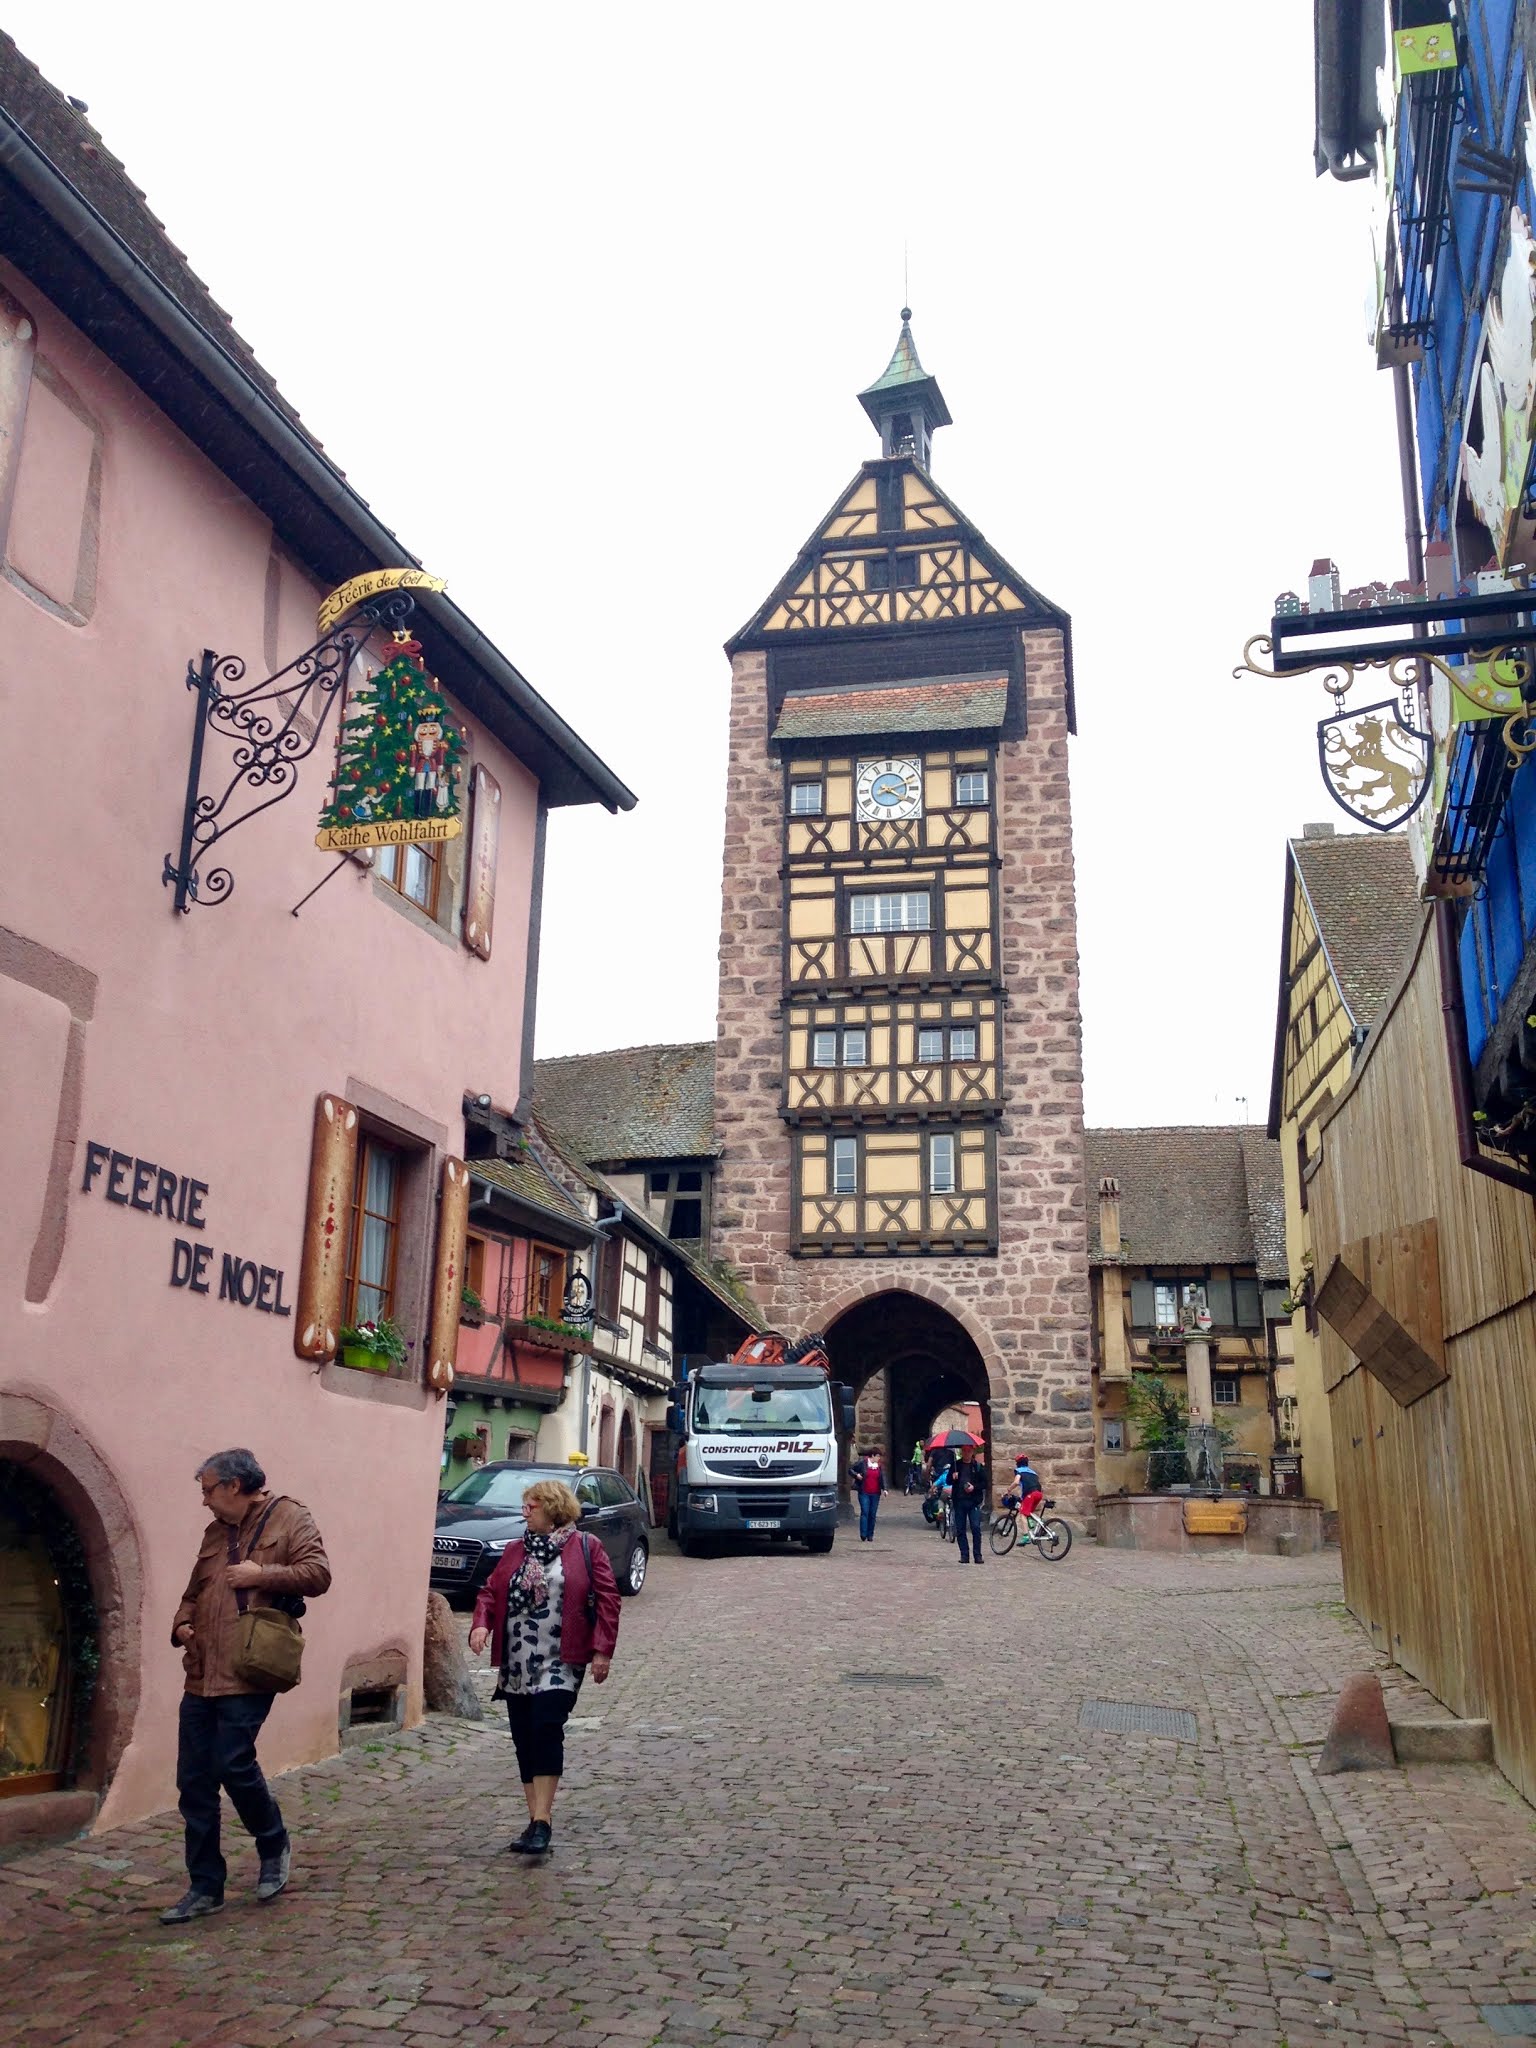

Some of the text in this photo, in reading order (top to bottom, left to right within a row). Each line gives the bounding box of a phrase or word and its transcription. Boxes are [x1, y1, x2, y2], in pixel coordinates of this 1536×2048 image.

[376, 572, 391, 588] de
[328, 821, 448, 847] Käthe Wohlfahrt
[82, 1140, 209, 1230] FEERIE
[170, 1237, 291, 1317] DE NOEL
[702, 1441, 814, 1454] CONSTRUCTION PILZ
